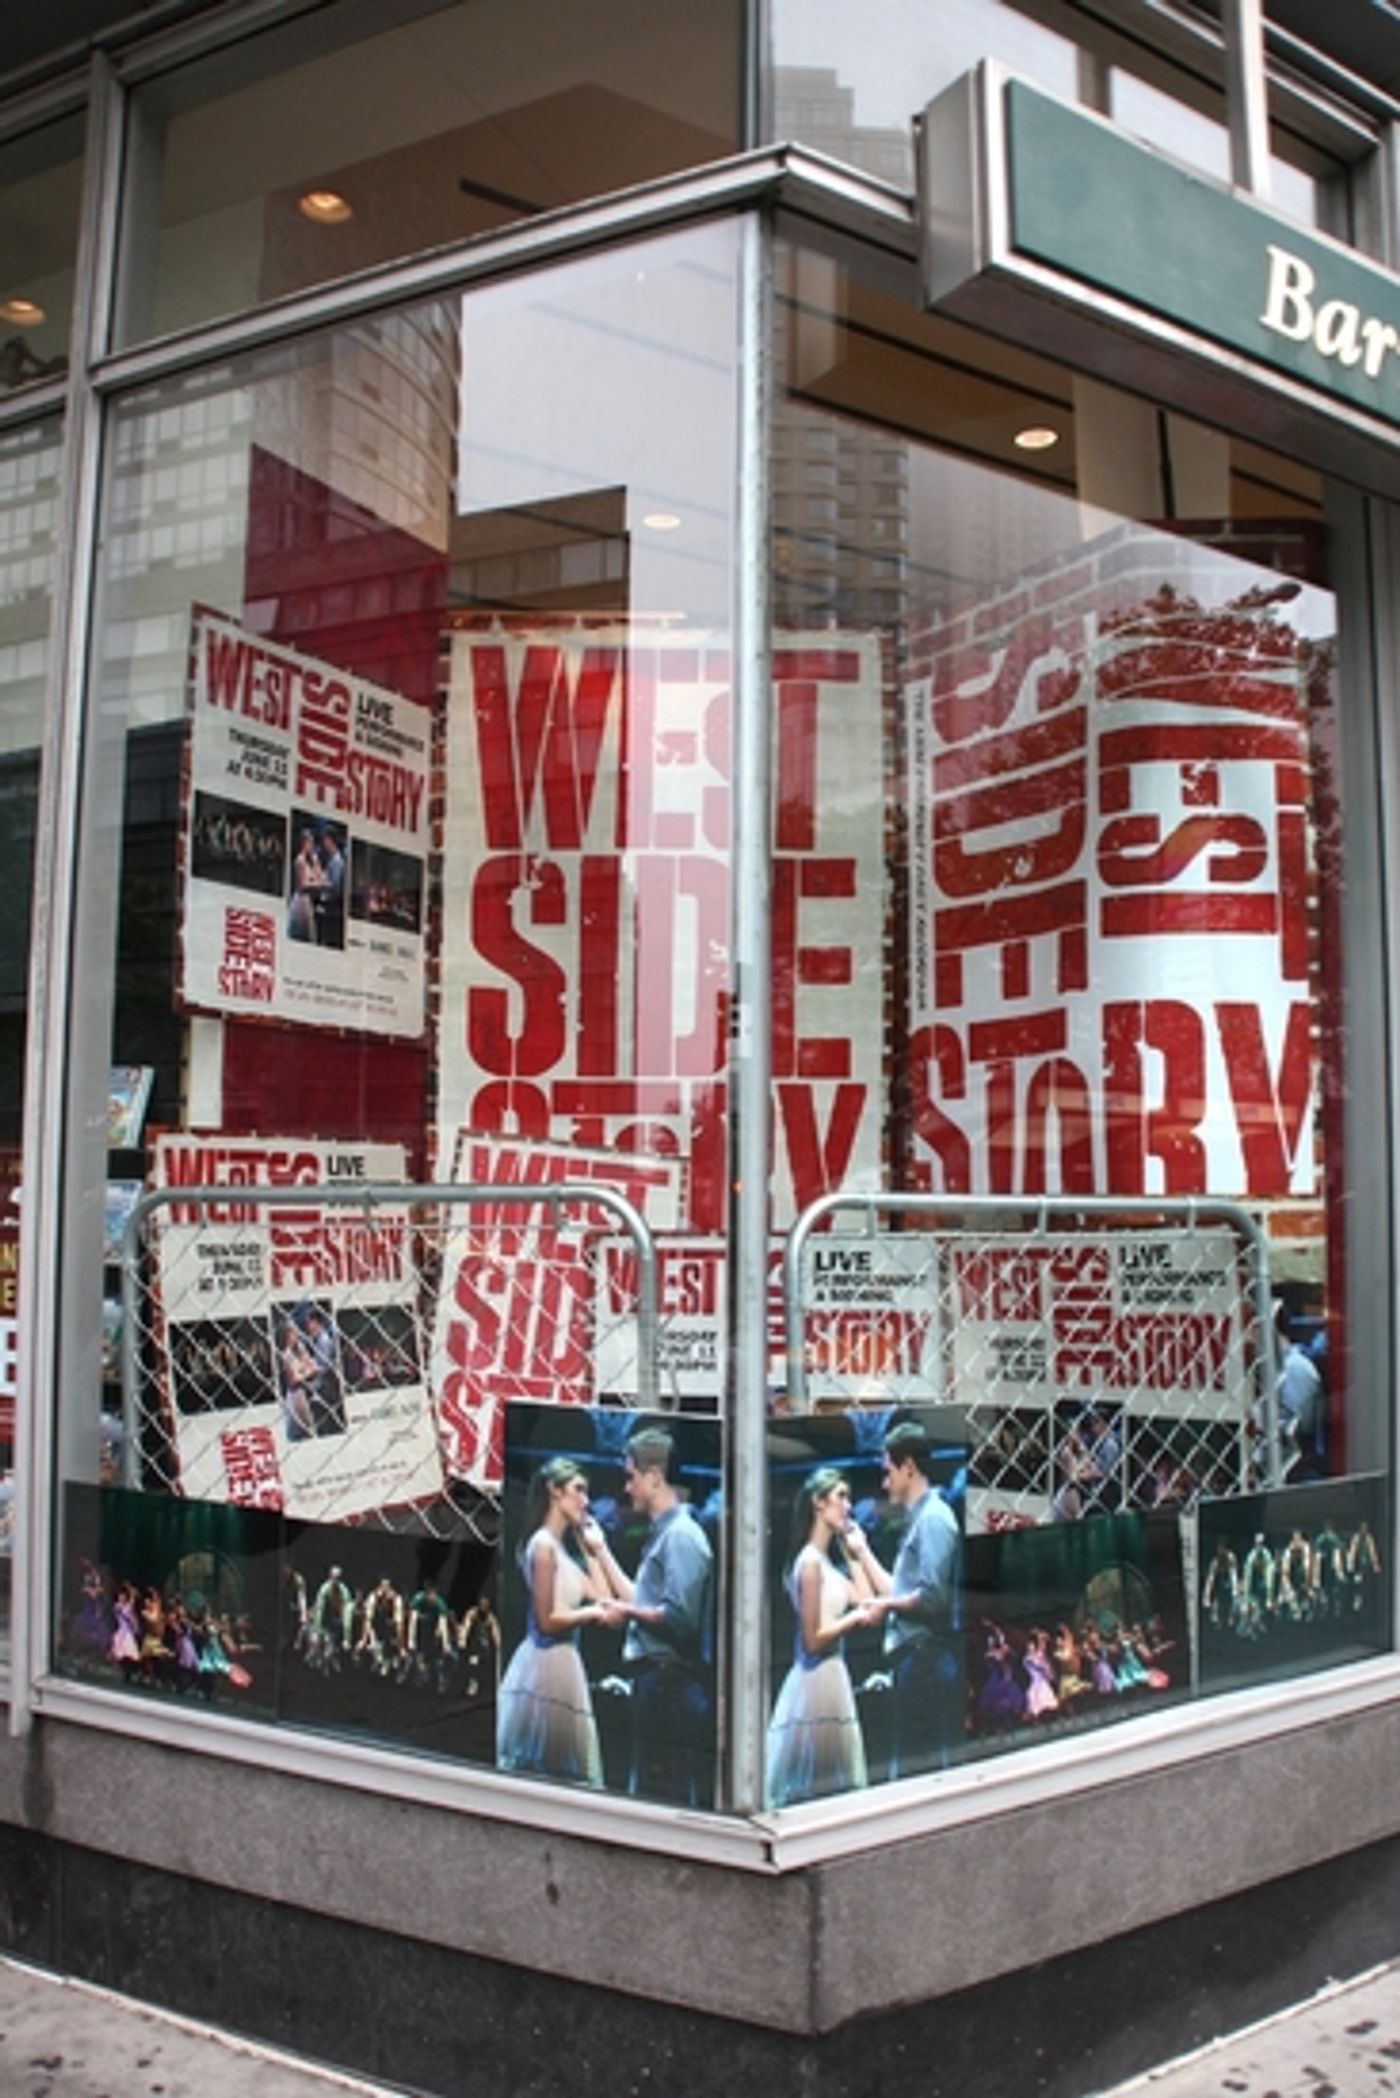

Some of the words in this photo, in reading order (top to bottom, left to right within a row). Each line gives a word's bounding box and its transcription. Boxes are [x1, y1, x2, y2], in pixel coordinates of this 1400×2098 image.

[1258, 245, 1400, 378] Bar
[205, 628, 302, 730] WEST
[356, 692, 394, 727] LIVE
[296, 670, 351, 812] SIDE
[346, 749, 425, 833] STORY
[468, 854, 857, 1078] SIDE
[164, 1148, 267, 1223] WEST
[327, 1155, 366, 1176] LIVE
[323, 1217, 405, 1286] STORY
[815, 1250, 872, 1271] LIVE
[954, 1247, 1052, 1322] WEST
[1119, 1245, 1172, 1268] LIVE
[804, 1311, 931, 1375] STORY
[1112, 1313, 1232, 1391] STORY
